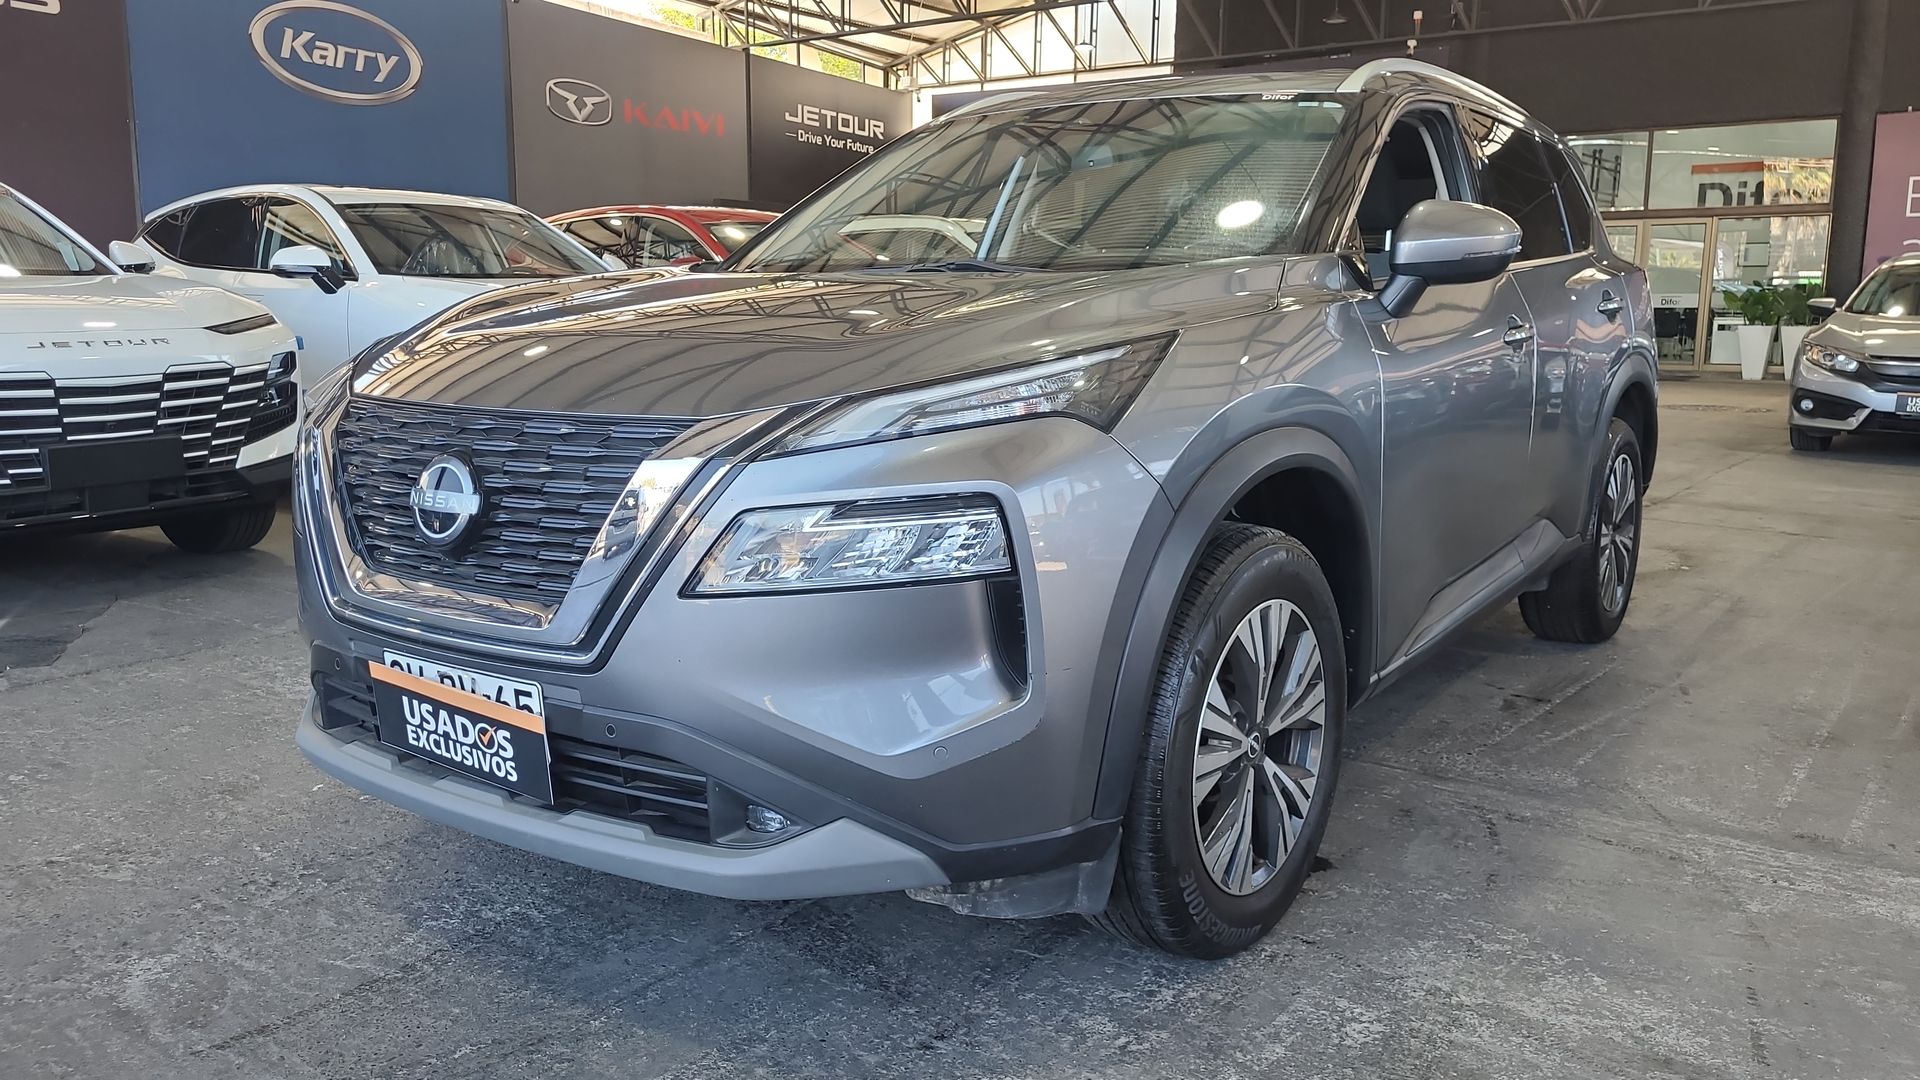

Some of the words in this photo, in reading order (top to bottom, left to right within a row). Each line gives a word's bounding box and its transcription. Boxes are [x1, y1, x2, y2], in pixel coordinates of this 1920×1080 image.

[280, 26, 400, 83] Karry
[784, 103, 884, 140] JETOUR
[797, 129, 823, 145] Drive
[823, 134, 846, 149] Your
[846, 138, 874, 154] Future
[27, 337, 170, 349] JETOUR
[409, 489, 476, 512] NISSAN
[402, 696, 514, 758] USADOS
[406, 724, 518, 782] EXCLUSIVOS
